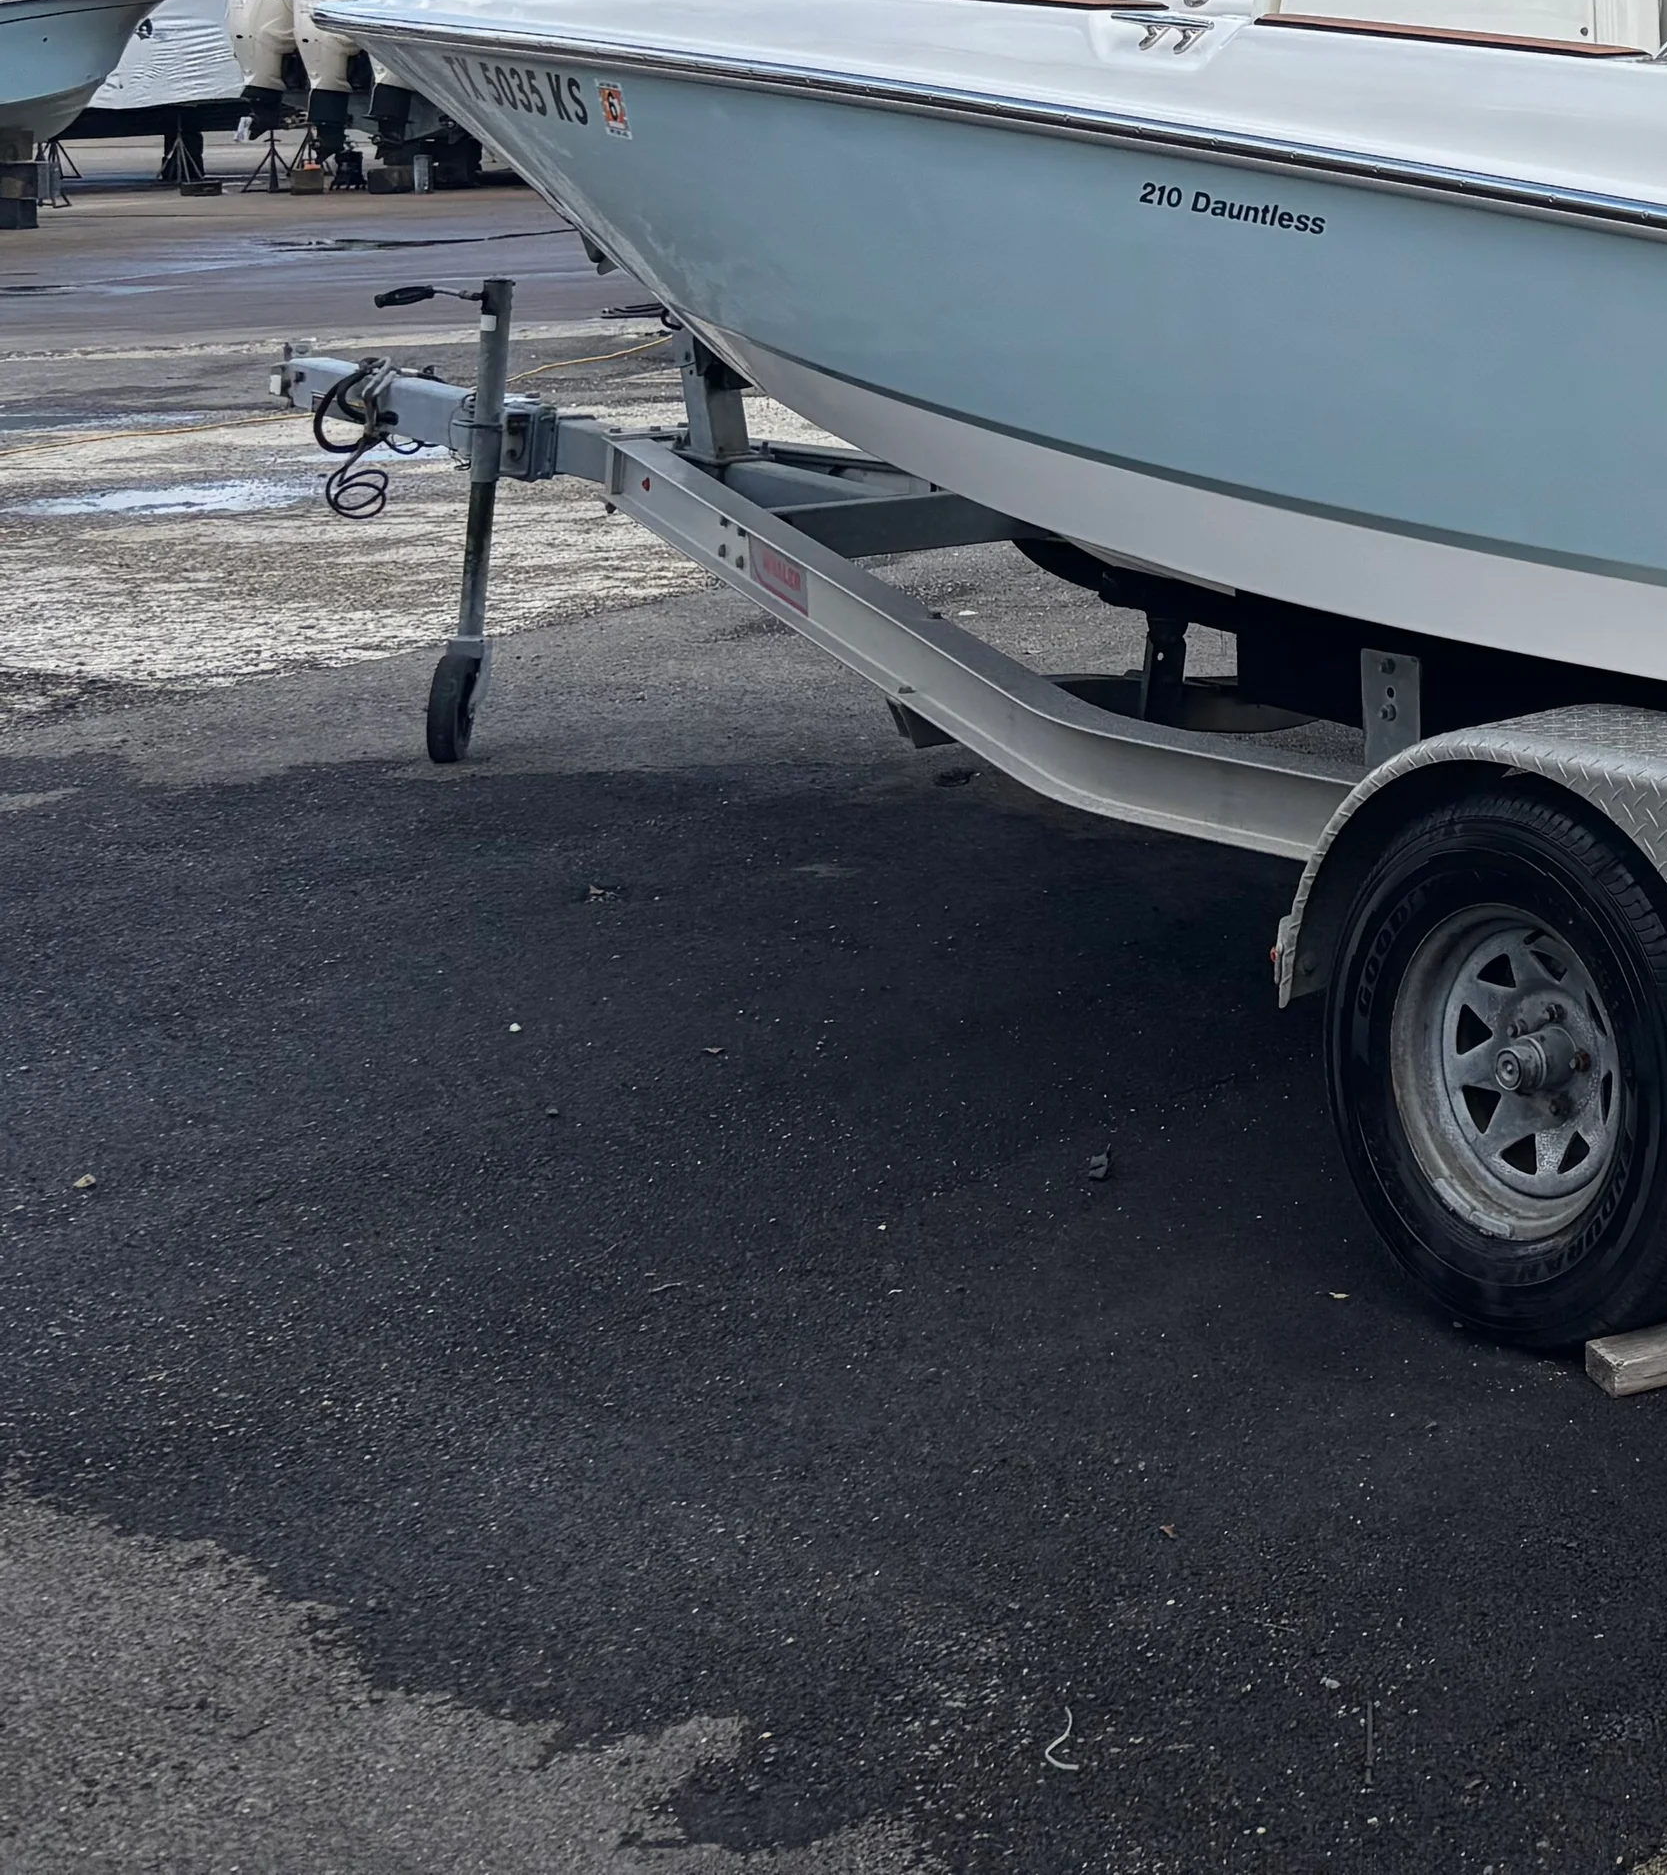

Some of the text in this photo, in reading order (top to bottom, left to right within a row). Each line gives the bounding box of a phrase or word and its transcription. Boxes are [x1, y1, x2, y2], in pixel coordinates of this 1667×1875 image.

[442, 55, 589, 127] TX 5035 KS
[1138, 181, 1327, 236] 210 Dauntless
